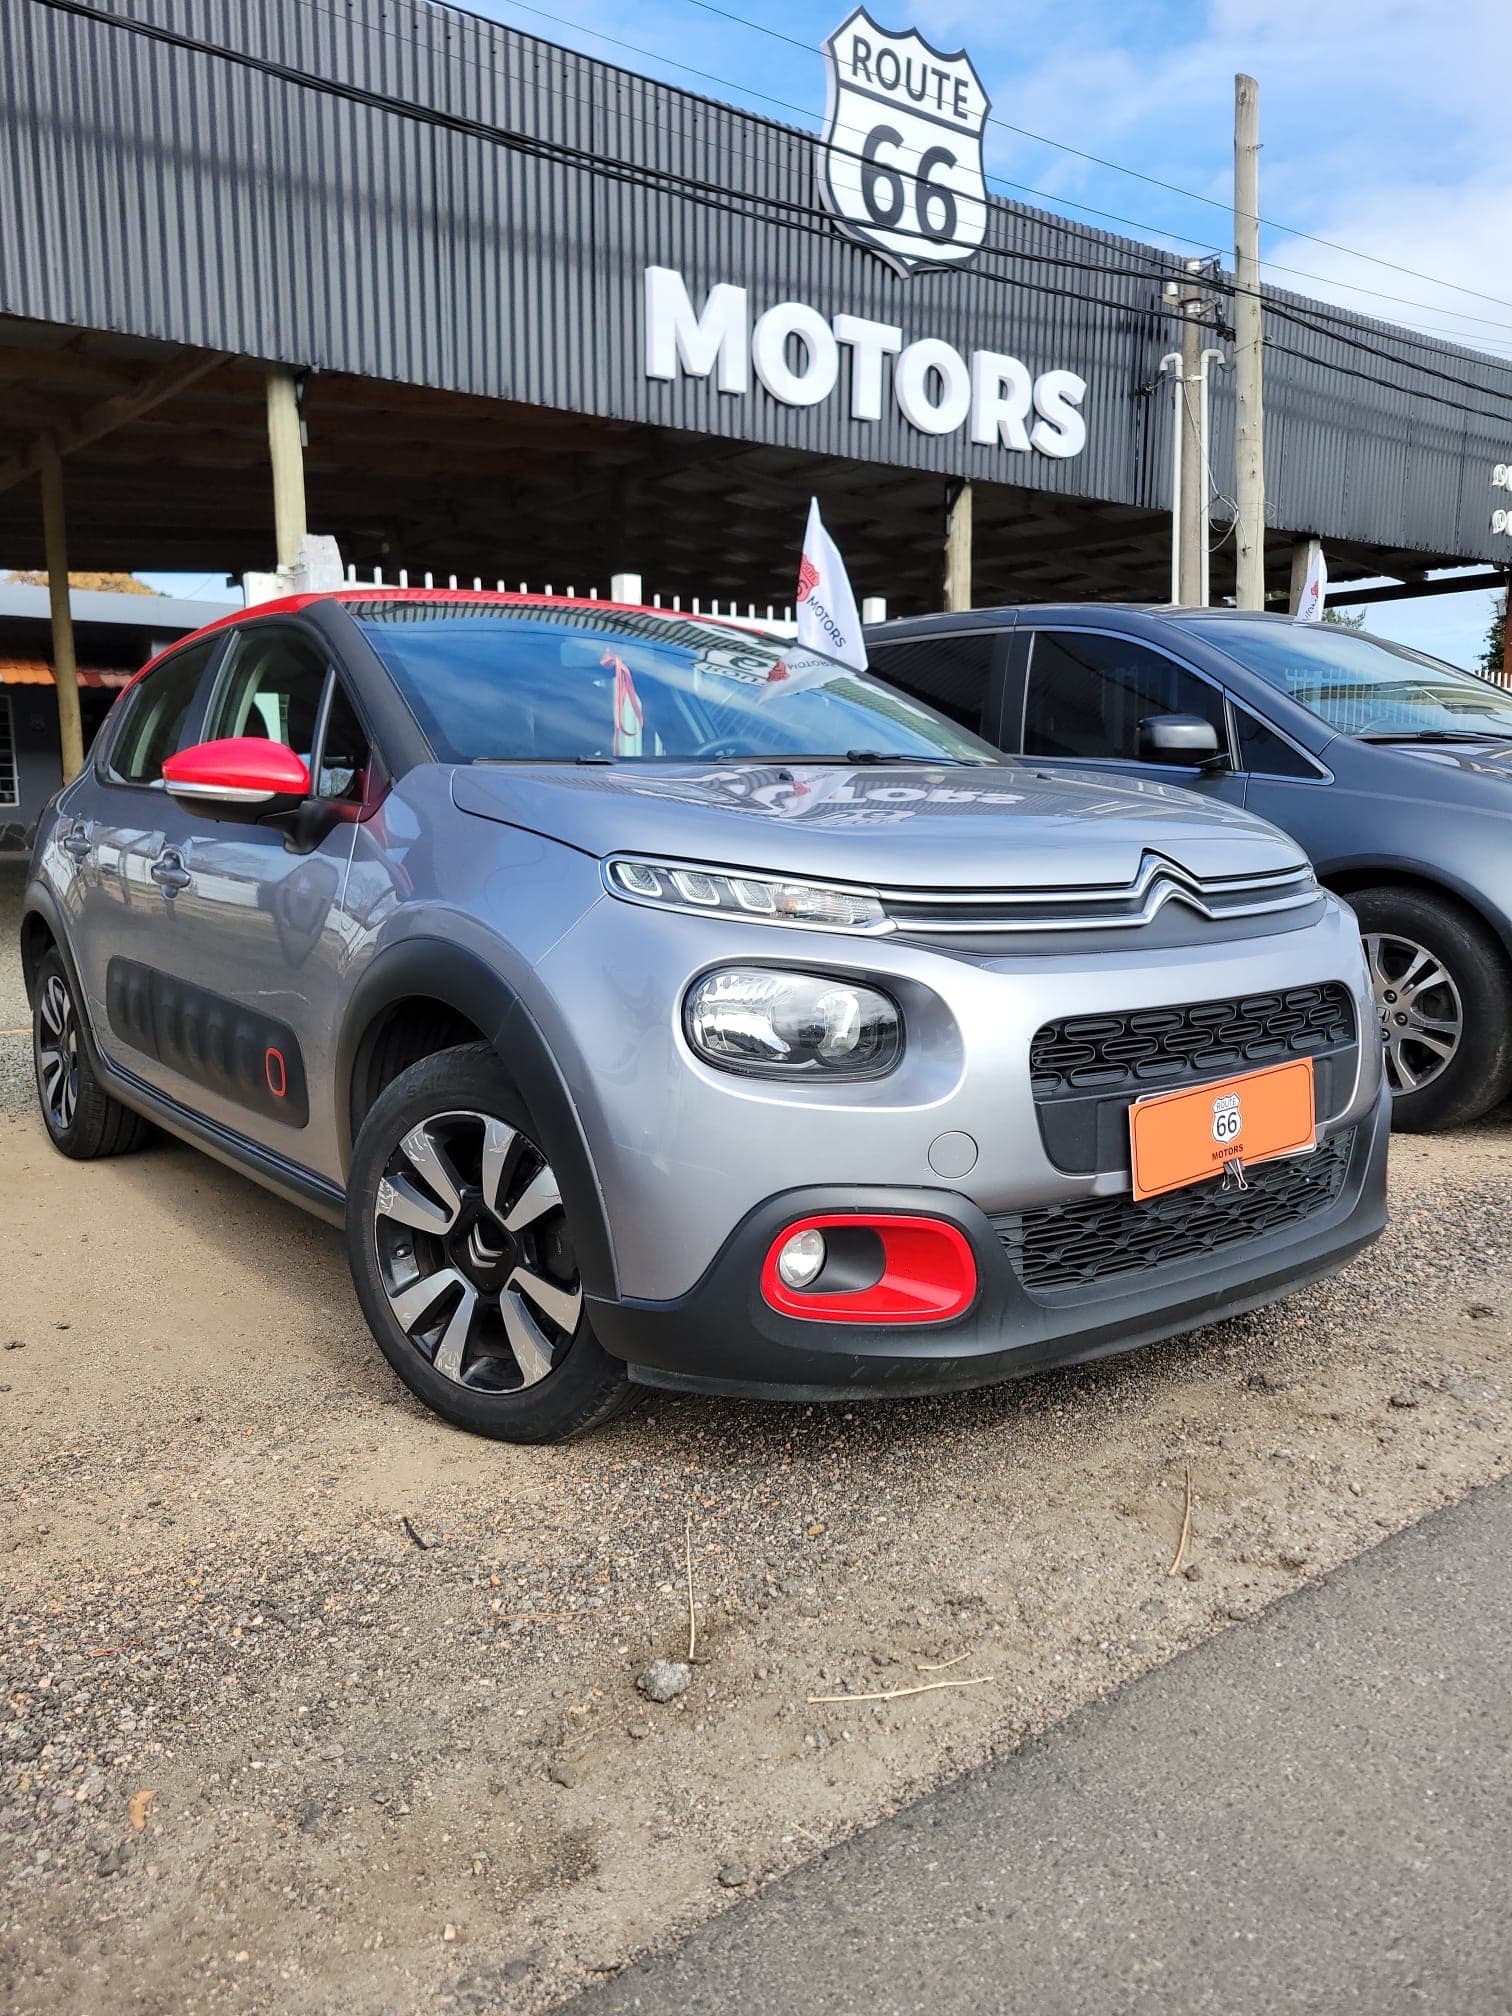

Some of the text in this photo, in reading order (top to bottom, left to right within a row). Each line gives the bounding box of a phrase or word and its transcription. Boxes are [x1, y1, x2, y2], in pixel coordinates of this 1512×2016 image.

[852, 34, 970, 121] ROUTE
[861, 124, 958, 246] 66
[644, 265, 1088, 460] MOTORS
[806, 595, 847, 648] MOTORS
[1216, 1097, 1237, 1110] ROUTE
[1216, 1111, 1238, 1137] 66
[1211, 1144, 1244, 1161] MOTORS
